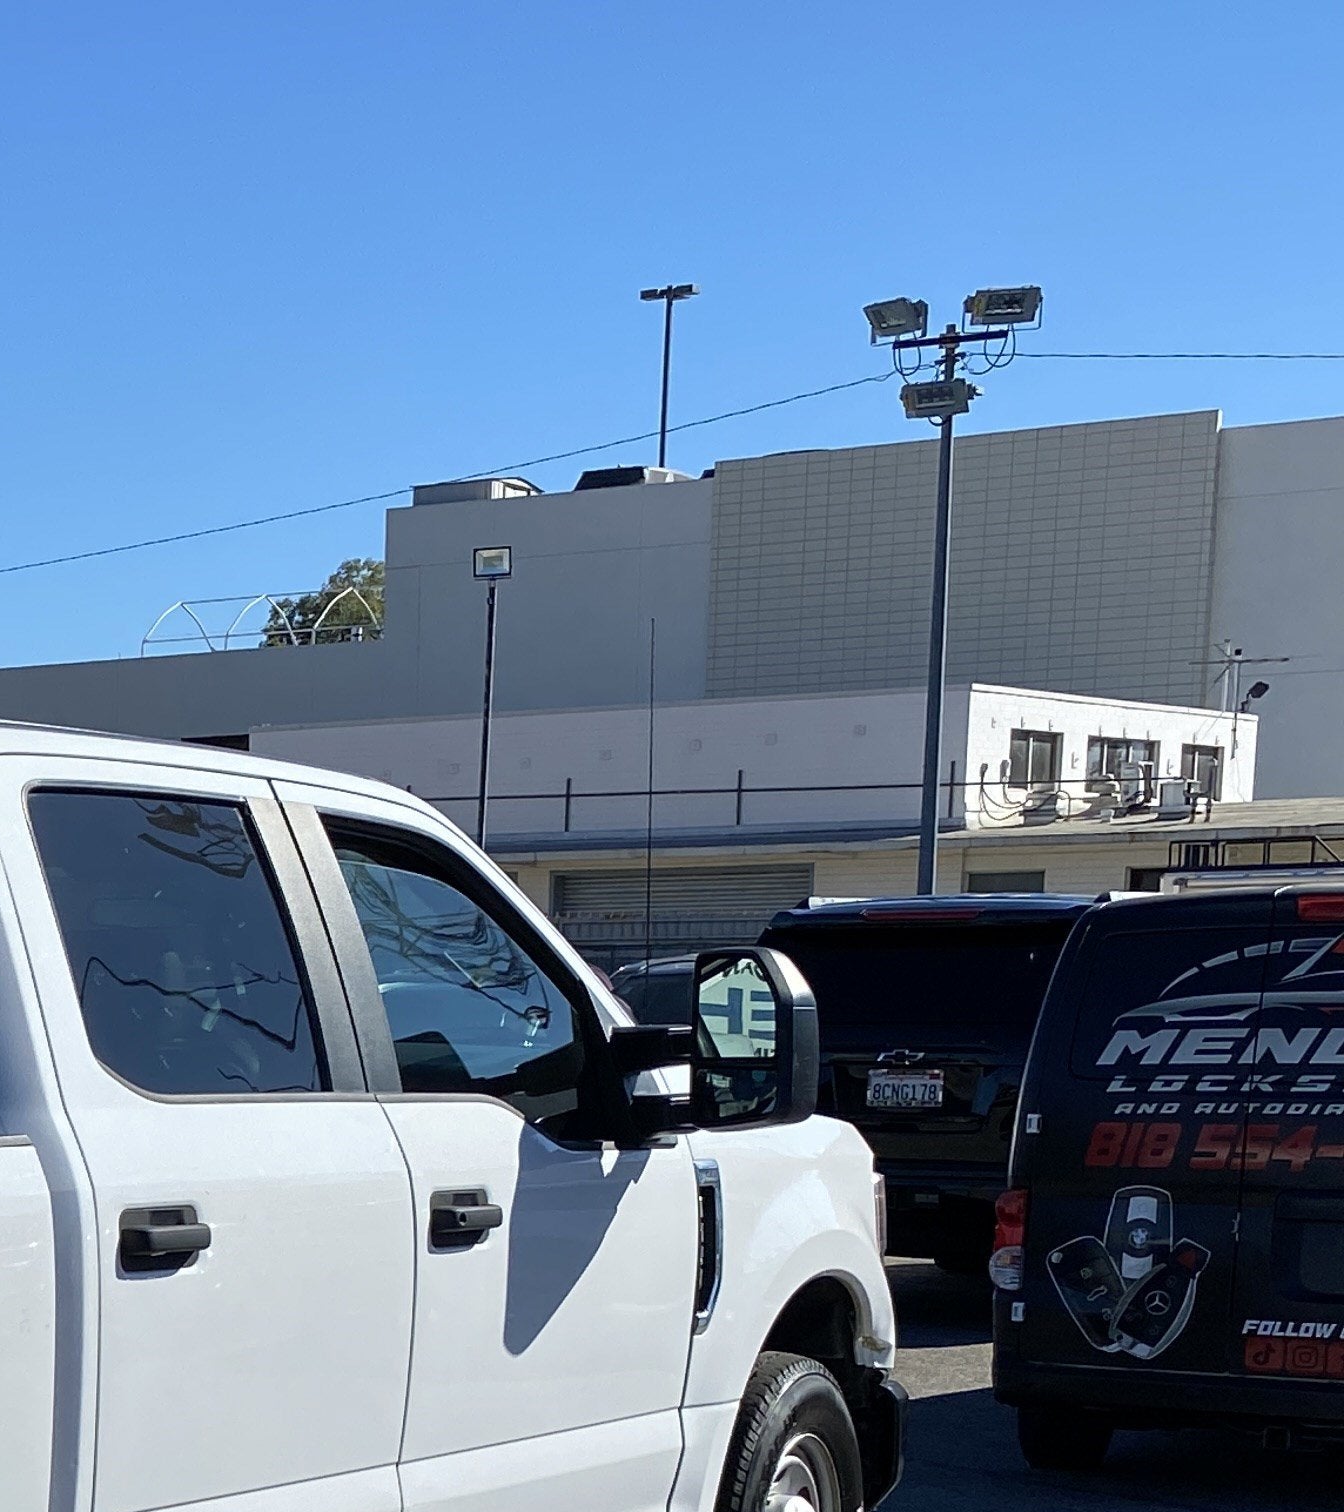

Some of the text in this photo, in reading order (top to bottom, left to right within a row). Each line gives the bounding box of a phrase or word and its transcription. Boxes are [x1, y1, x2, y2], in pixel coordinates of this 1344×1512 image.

[872, 1083, 937, 1101] 8CNG178
[1105, 1074, 1344, 1092] LOCKS
[1113, 1102, 1181, 1115] AND
[1084, 1121, 1183, 1168] 818
[1241, 1318, 1338, 1339] FOLLOW
